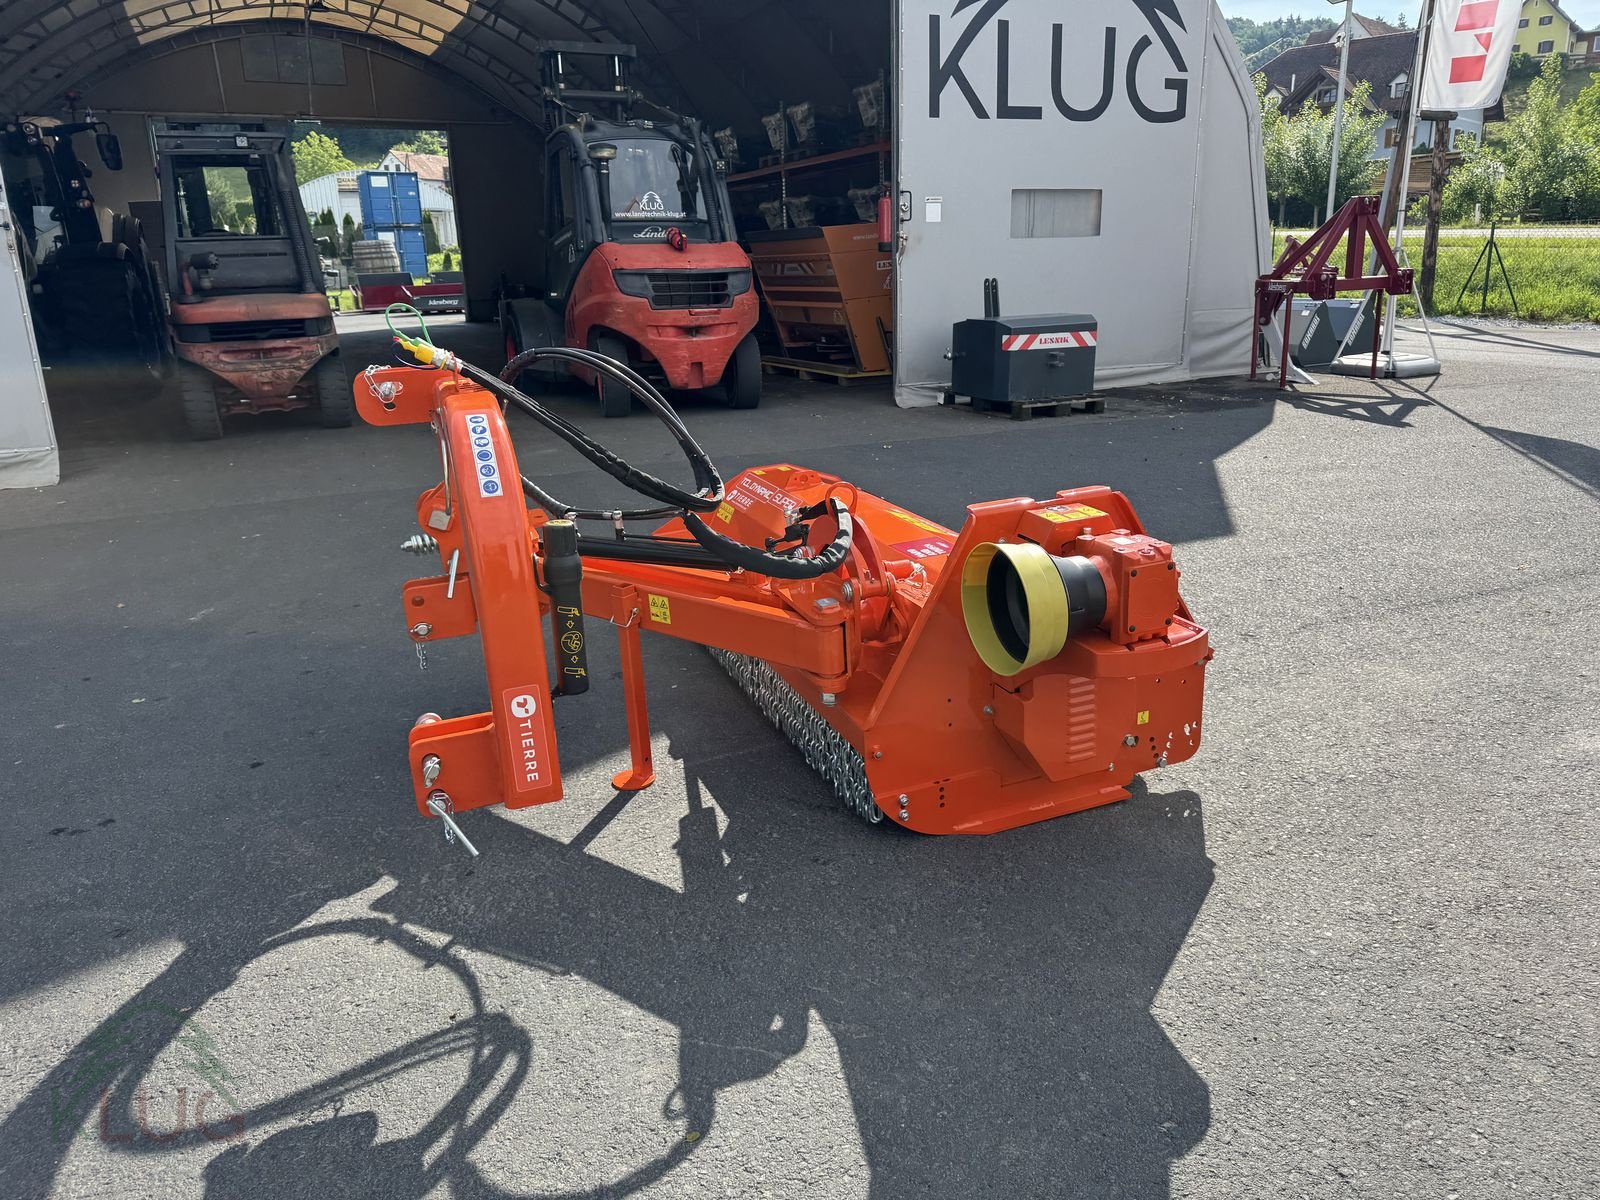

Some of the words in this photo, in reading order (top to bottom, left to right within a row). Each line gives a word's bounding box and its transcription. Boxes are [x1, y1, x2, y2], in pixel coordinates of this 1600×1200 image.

[929, 14, 1189, 124] KLUG
[640, 202, 664, 210] KLUG
[633, 226, 669, 239] Lind
[735, 492, 753, 507] TIERRE
[749, 482, 775, 500] DYNAMIC
[772, 493, 797, 509] SUPER
[520, 719, 539, 782] TIERRE
